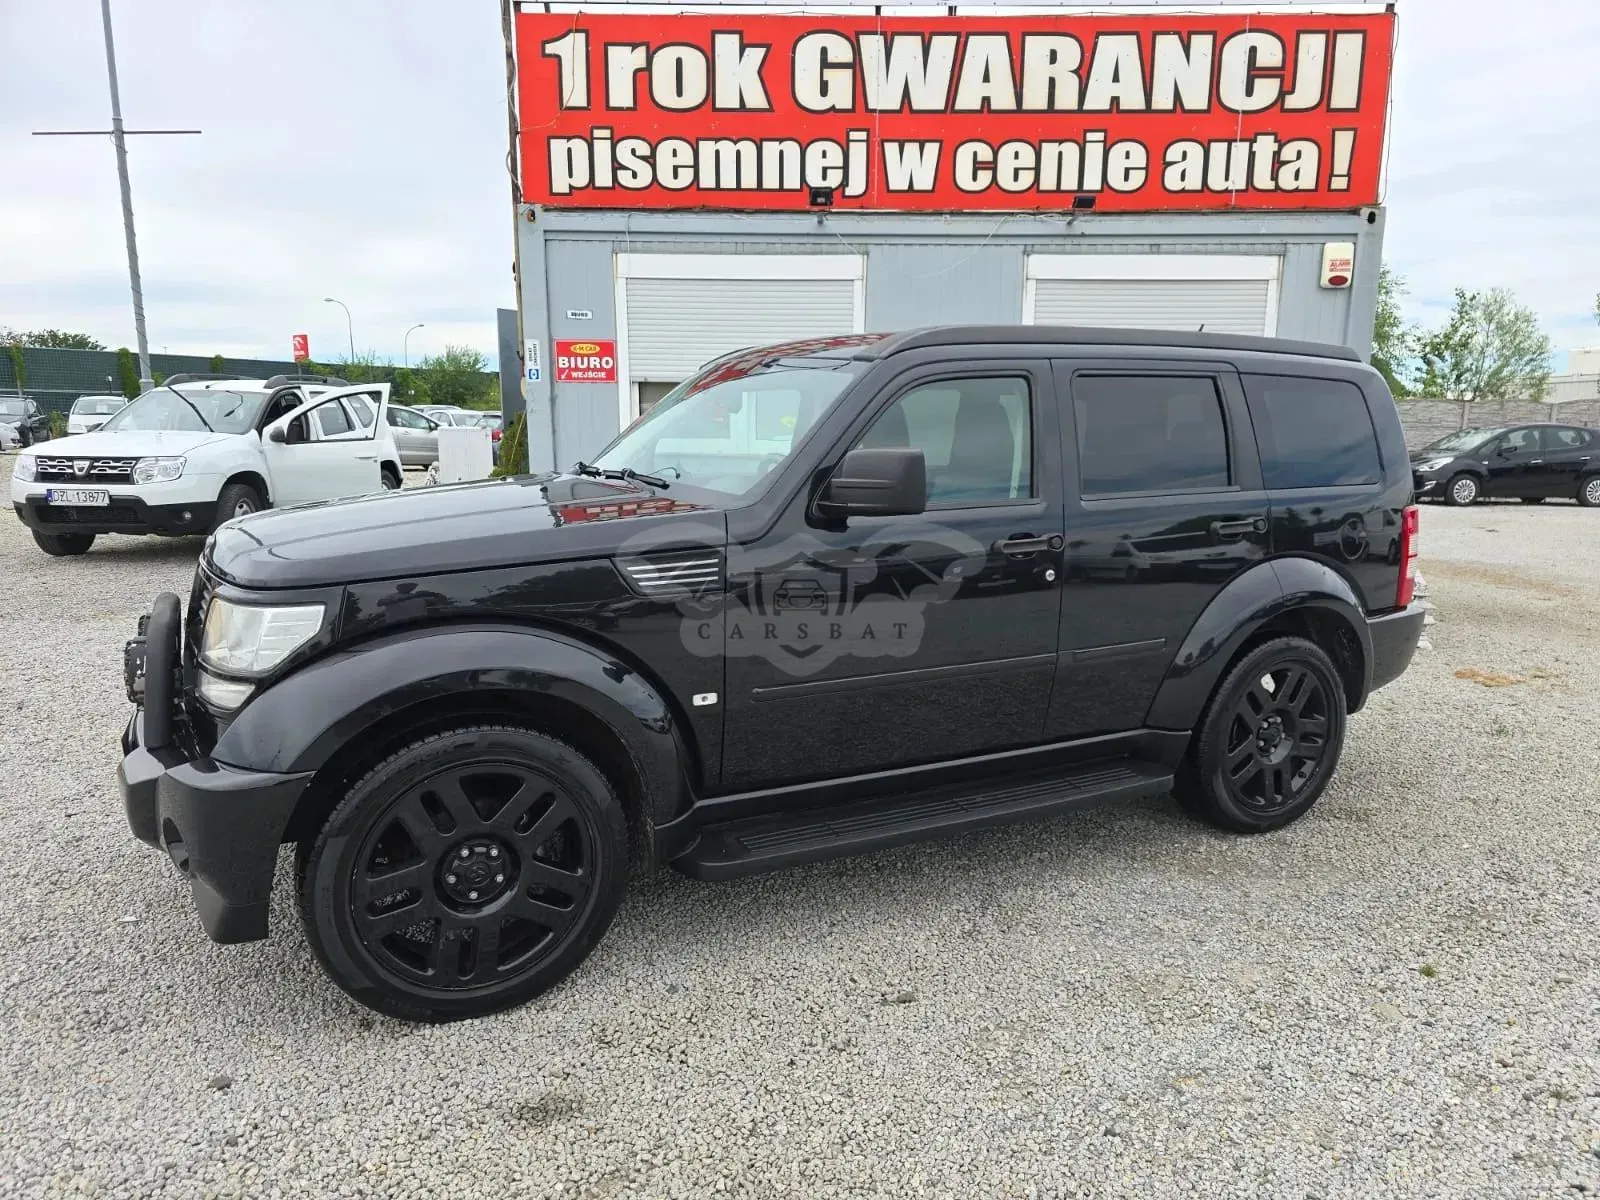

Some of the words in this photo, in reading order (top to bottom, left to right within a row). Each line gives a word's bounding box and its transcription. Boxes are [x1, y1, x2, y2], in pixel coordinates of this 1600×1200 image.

[541, 29, 591, 110] 1
[604, 30, 774, 113] rok
[792, 28, 1367, 114] GWARANCJI
[547, 127, 870, 198] pisemnej
[881, 139, 943, 193] w
[953, 129, 1149, 193] cenie
[558, 356, 614, 369] BIURO
[571, 370, 607, 379] WEJŚCIE
[52, 490, 72, 502] DZL
[76, 491, 106, 503] 13877
